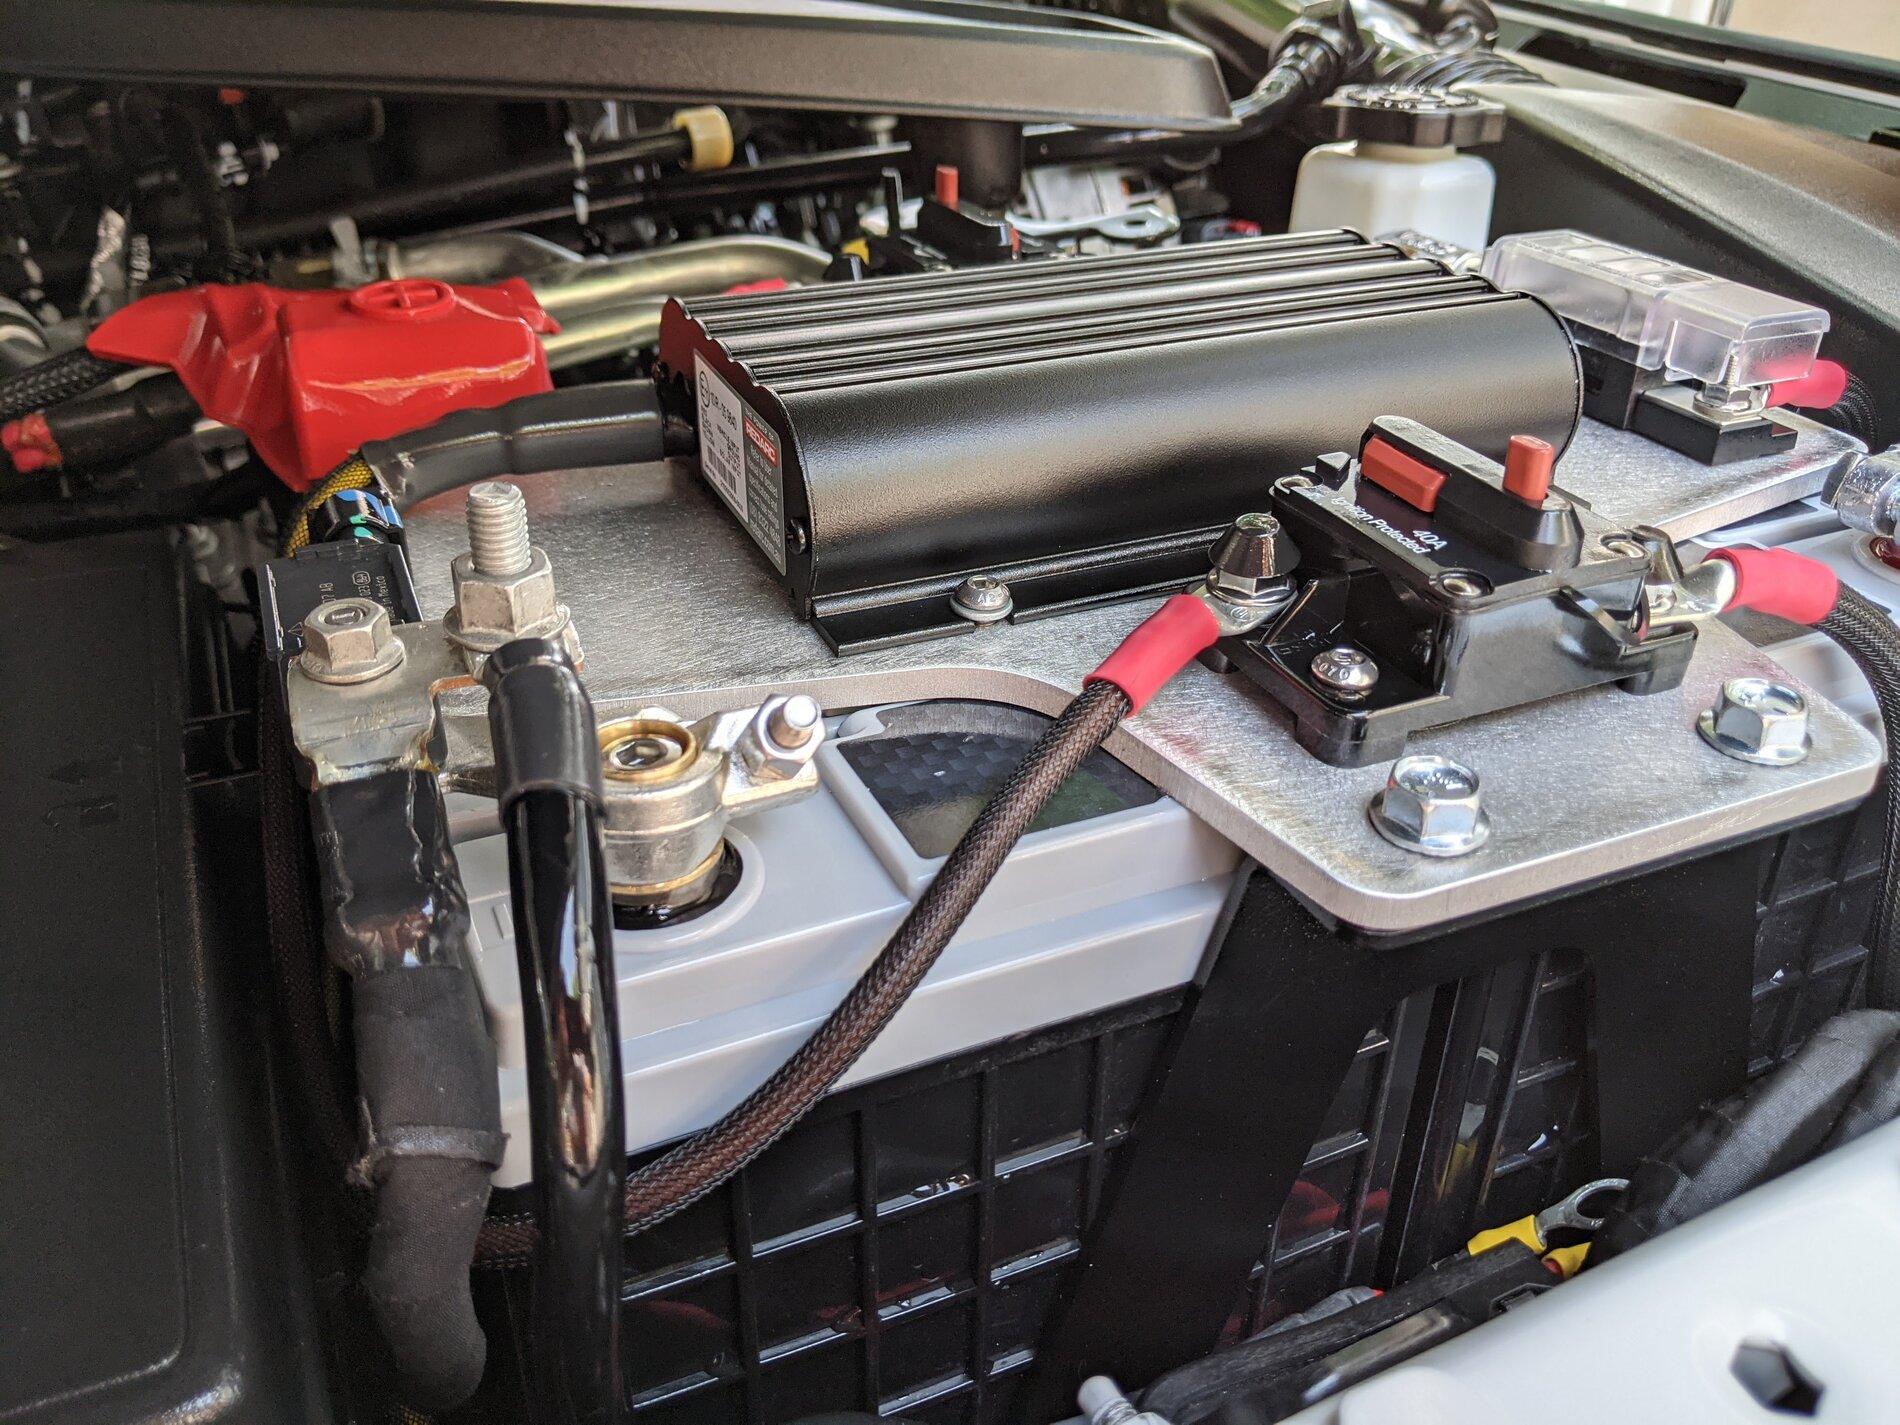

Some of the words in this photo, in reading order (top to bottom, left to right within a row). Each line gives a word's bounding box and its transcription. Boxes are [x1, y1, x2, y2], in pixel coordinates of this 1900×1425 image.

[746, 422, 776, 464] REDARC
[1331, 496, 1374, 521] Ignition
[1368, 518, 1432, 554] Protected
[1413, 530, 1448, 551] 40A
[376, 575, 390, 597] Mexico
